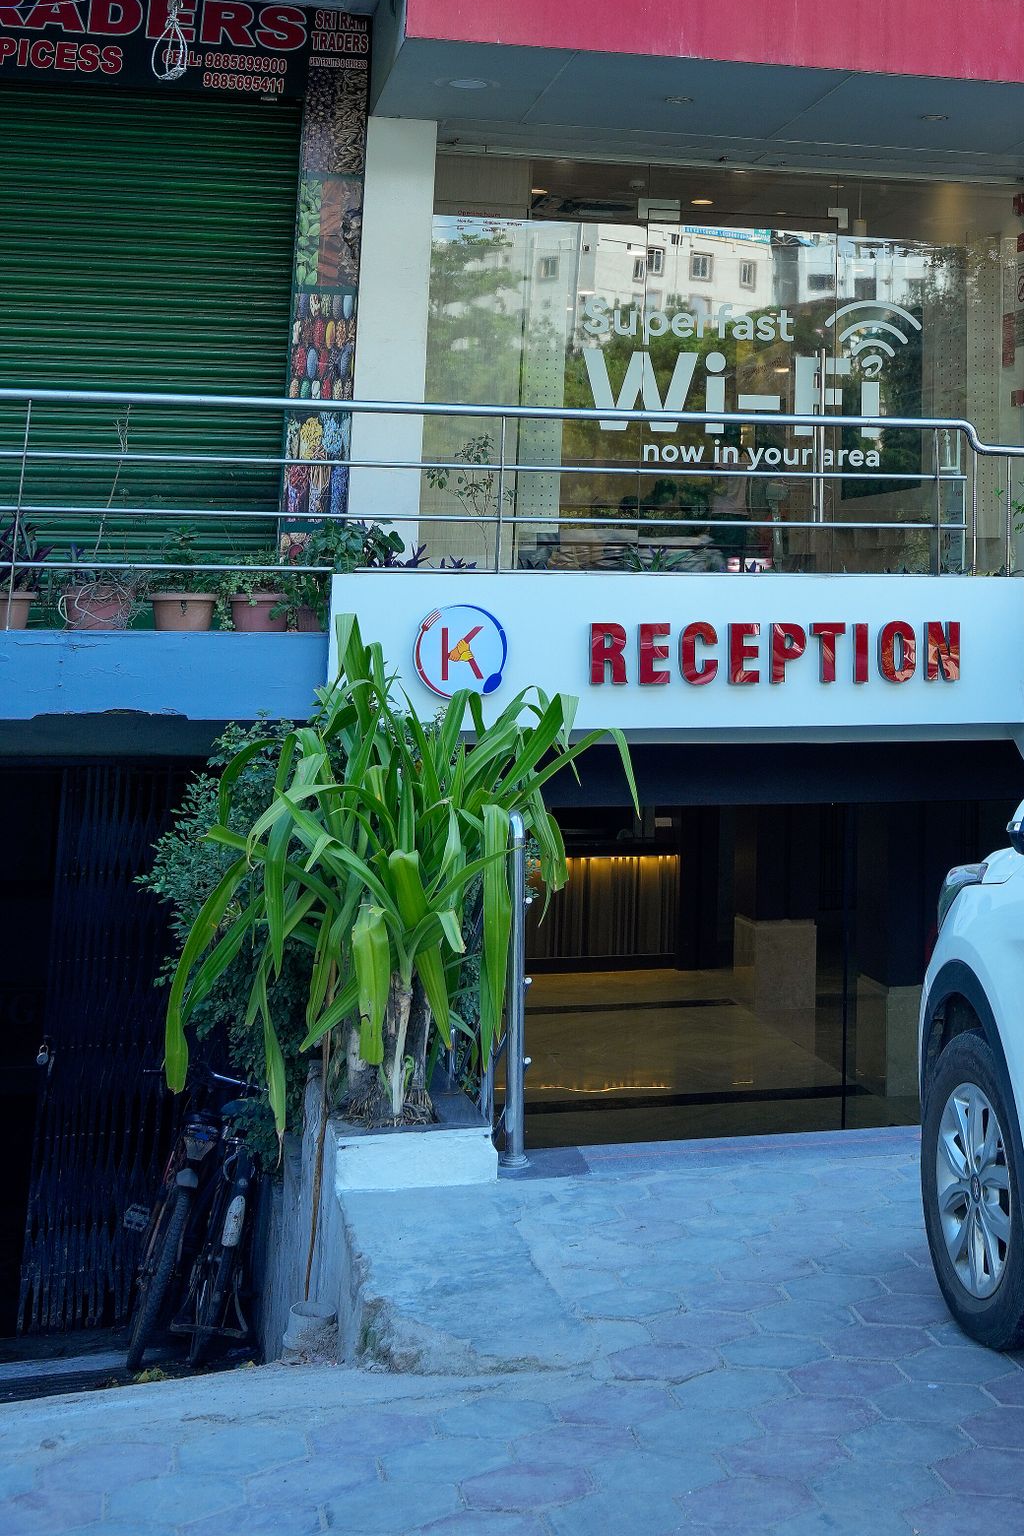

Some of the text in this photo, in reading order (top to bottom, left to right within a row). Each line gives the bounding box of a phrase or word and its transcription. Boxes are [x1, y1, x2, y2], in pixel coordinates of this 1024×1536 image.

[315, 10, 337, 30] SRI
[311, 31, 369, 53] TRADERS
[205, 52, 288, 73] 9885899900
[203, 72, 284, 93] 9885695411
[582, 298, 795, 346] Superfast
[582, 347, 880, 438] Wi-Fi
[643, 439, 881, 470] now in your area
[588, 620, 962, 688] RECEPTION
